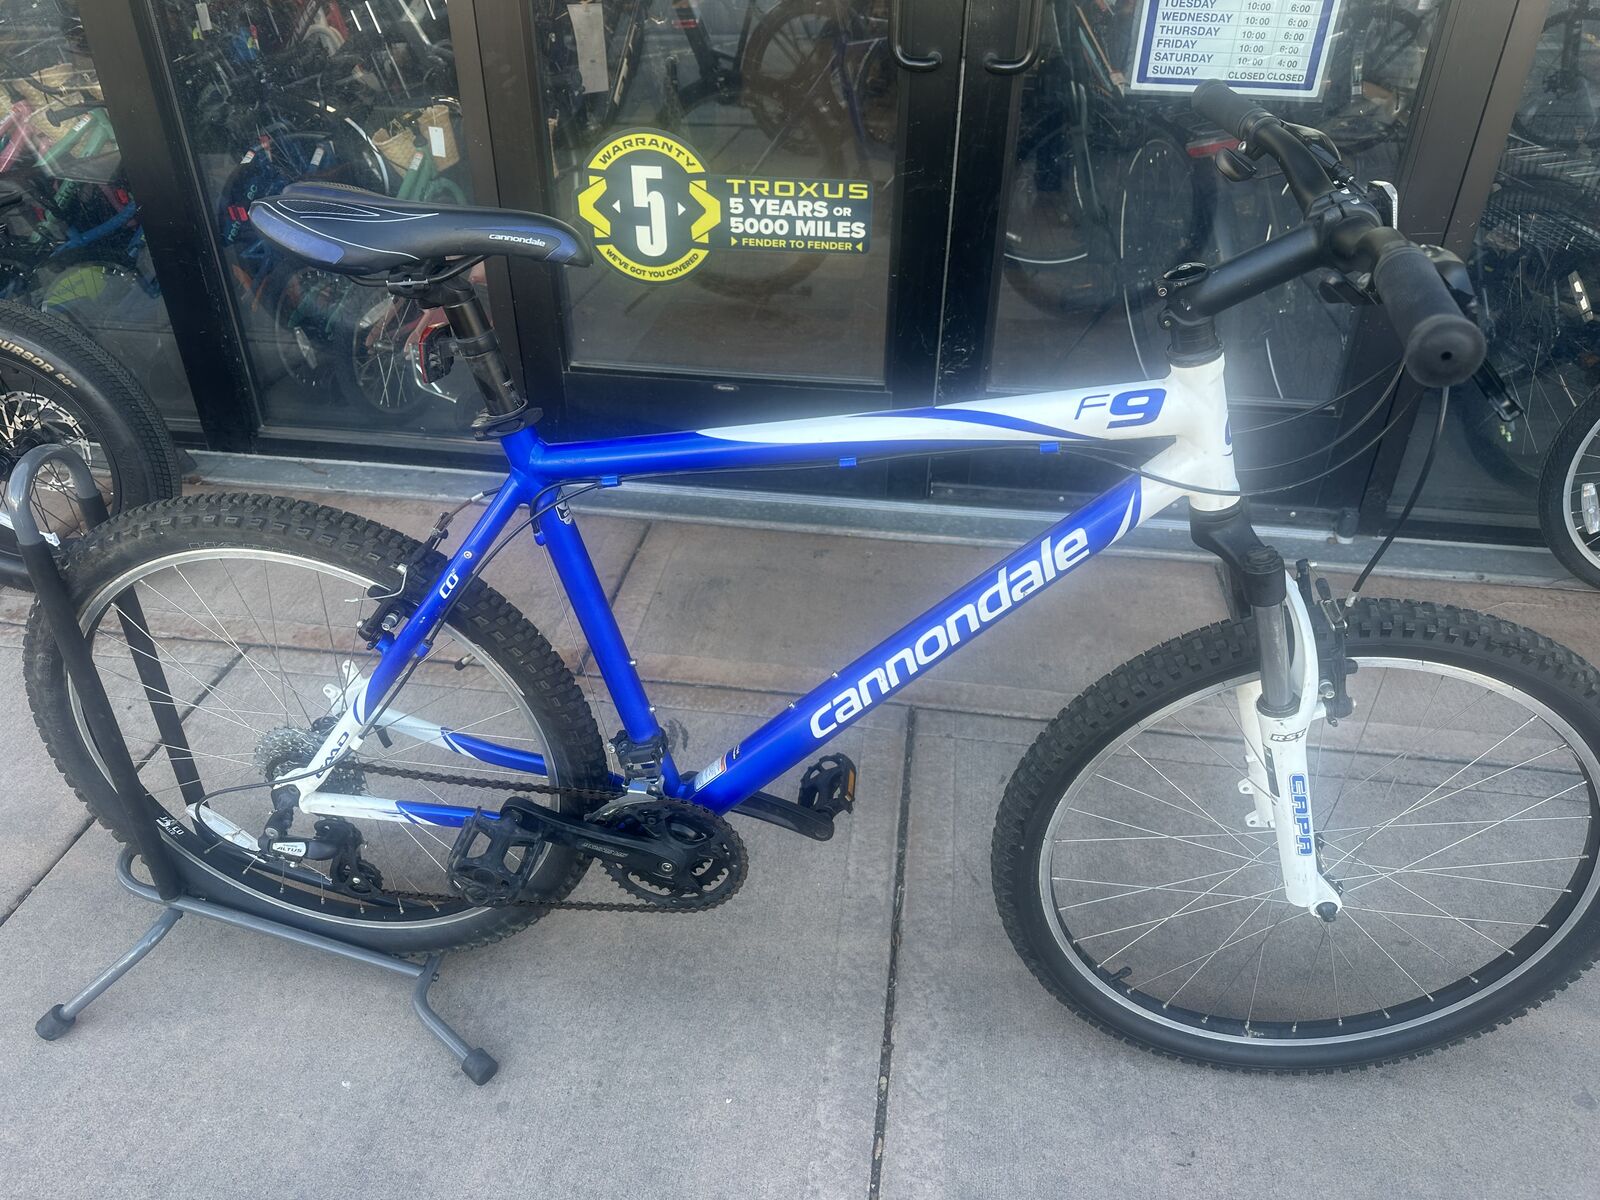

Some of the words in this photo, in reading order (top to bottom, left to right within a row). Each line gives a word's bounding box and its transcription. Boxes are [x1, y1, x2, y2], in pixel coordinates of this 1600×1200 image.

[1163, 0, 1217, 9] TUESDAY
[1247, 2, 1272, 11] 10:00
[1290, 4, 1311, 13] 6:00
[1161, 11, 1234, 24] WEDNESDAY
[1245, 16, 1270, 26] 10:00
[1287, 18, 1309, 28] 6:00
[1159, 25, 1220, 37] THURSDAY
[1242, 30, 1266, 40] 10:00
[1283, 32, 1305, 42] 6:00
[1156, 38, 1198, 50] FRIDAY
[1239, 44, 1264, 54] 10:00
[1279, 45, 1299, 55] 6:00
[1154, 52, 1214, 64] SATURDAY
[1237, 57, 1263, 66] 10:00
[1277, 59, 1298, 69] 4:00
[1151, 65, 1199, 77] SUNDAY
[1228, 71, 1265, 81] CLOSED
[1266, 72, 1305, 82] CLOSED
[598, 137, 696, 167] WARRANTY
[725, 179, 869, 200] TROXUS
[630, 165, 668, 257] 5
[729, 197, 744, 214] 5
[749, 198, 829, 218] YEARS
[832, 206, 852, 217] OR
[729, 217, 790, 236] 5000
[795, 219, 866, 239] MILES
[488, 233, 546, 248] cannondale
[741, 238, 787, 248] FENDER
[789, 239, 805, 249] TO
[807, 240, 853, 251] FENDER
[606, 248, 629, 270] WE'VE
[629, 266, 647, 277] GOT
[648, 270, 666, 278] YOU
[666, 253, 699, 276] COVERED
[0, 338, 55, 373] URSOR
[1074, 388, 1167, 429] F9
[809, 527, 1090, 740] cannondale
[1270, 728, 1307, 742] RST
[1288, 773, 1313, 857] CAPA
